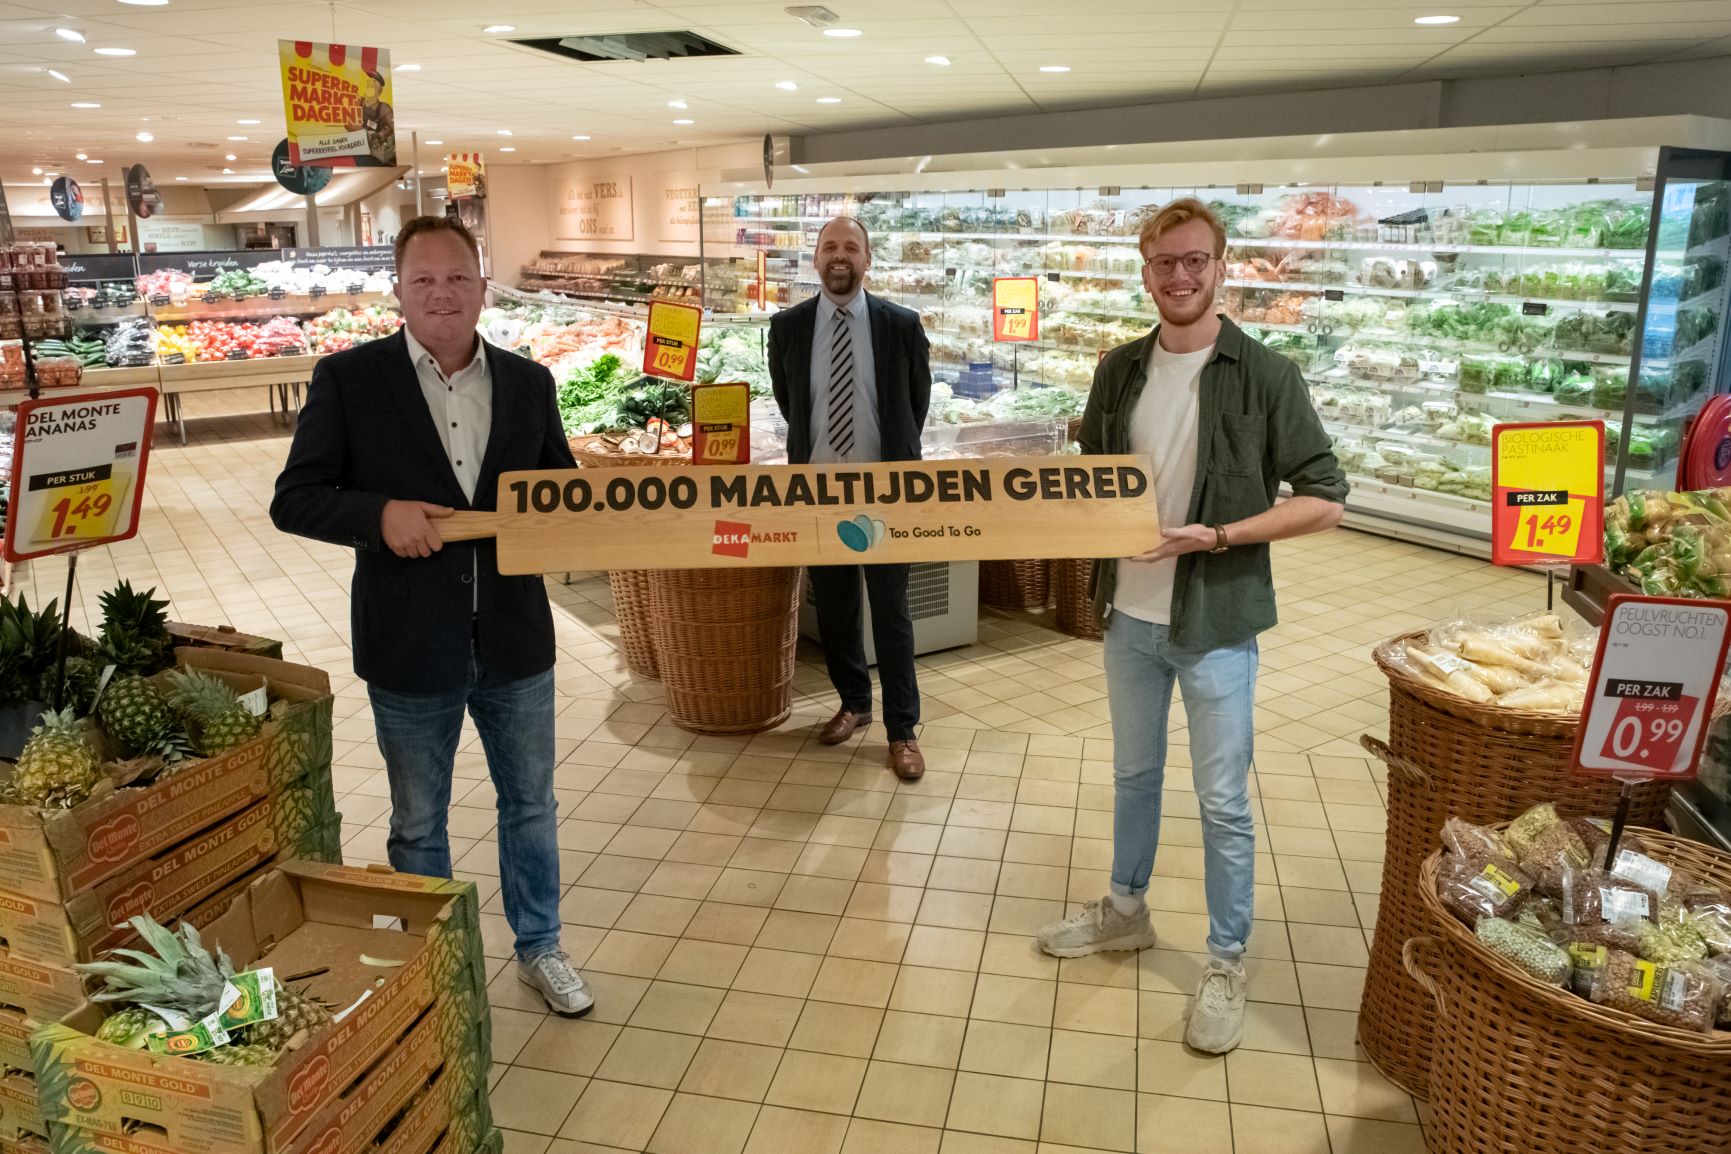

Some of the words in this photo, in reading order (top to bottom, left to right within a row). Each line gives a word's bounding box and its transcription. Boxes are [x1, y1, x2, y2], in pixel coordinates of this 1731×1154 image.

[292, 103, 363, 125] DAGEN!
[593, 182, 617, 199] VERS
[579, 219, 598, 234] ONS
[208, 257, 240, 268] kruiden
[659, 352, 684, 368] 0.99
[27, 411, 57, 425] DEL
[61, 403, 121, 421] MONTE
[25, 418, 97, 438] ANANAS
[1502, 430, 1585, 444] BIOLOGISCHE
[709, 439, 736, 457] 0.99
[1502, 443, 1569, 455] PASTINAAK
[47, 475, 67, 486] PER
[69, 470, 96, 483] STUK
[510, 476, 698, 513] 100.000
[710, 468, 992, 508] MAALTIJDEN
[1003, 466, 1148, 501] GERED
[1517, 494, 1535, 503] PER
[1536, 493, 1558, 502] ZAK
[51, 493, 112, 538] 1.49
[889, 527, 909, 538] Too
[912, 525, 945, 538] Good
[947, 526, 961, 537] To
[963, 525, 981, 537] Go
[1526, 513, 1572, 548] 1.49
[1619, 607, 1725, 627] PEULVRUCHTEN
[1616, 621, 1670, 637] OOGST
[1616, 683, 1641, 696] PER
[1643, 684, 1672, 698] ZAK
[1612, 716, 1683, 758] 0.99
[137, 792, 167, 815] DEL
[170, 766, 224, 798] MONTE
[227, 744, 265, 770] GOLD
[108, 822, 138, 842] Monte
[152, 858, 181, 882] DEL
[184, 826, 235, 863] MONTE
[237, 803, 271, 831] GOLD
[153, 896, 182, 916] EXTRA
[183, 876, 211, 897] SWEET
[327, 1027, 354, 1053] DEL
[357, 984, 399, 1029] MONTE
[401, 951, 429, 985] GOLD
[85, 1062, 105, 1076] DEL
[111, 1066, 156, 1086] MONTE
[159, 1079, 196, 1094] GOLD
[340, 1098, 365, 1125] DEL
[366, 1050, 408, 1097] MONTE
[410, 1017, 438, 1049] GOLD
[424, 1081, 448, 1116] GOLD
[103, 1136, 125, 1151] DEL
